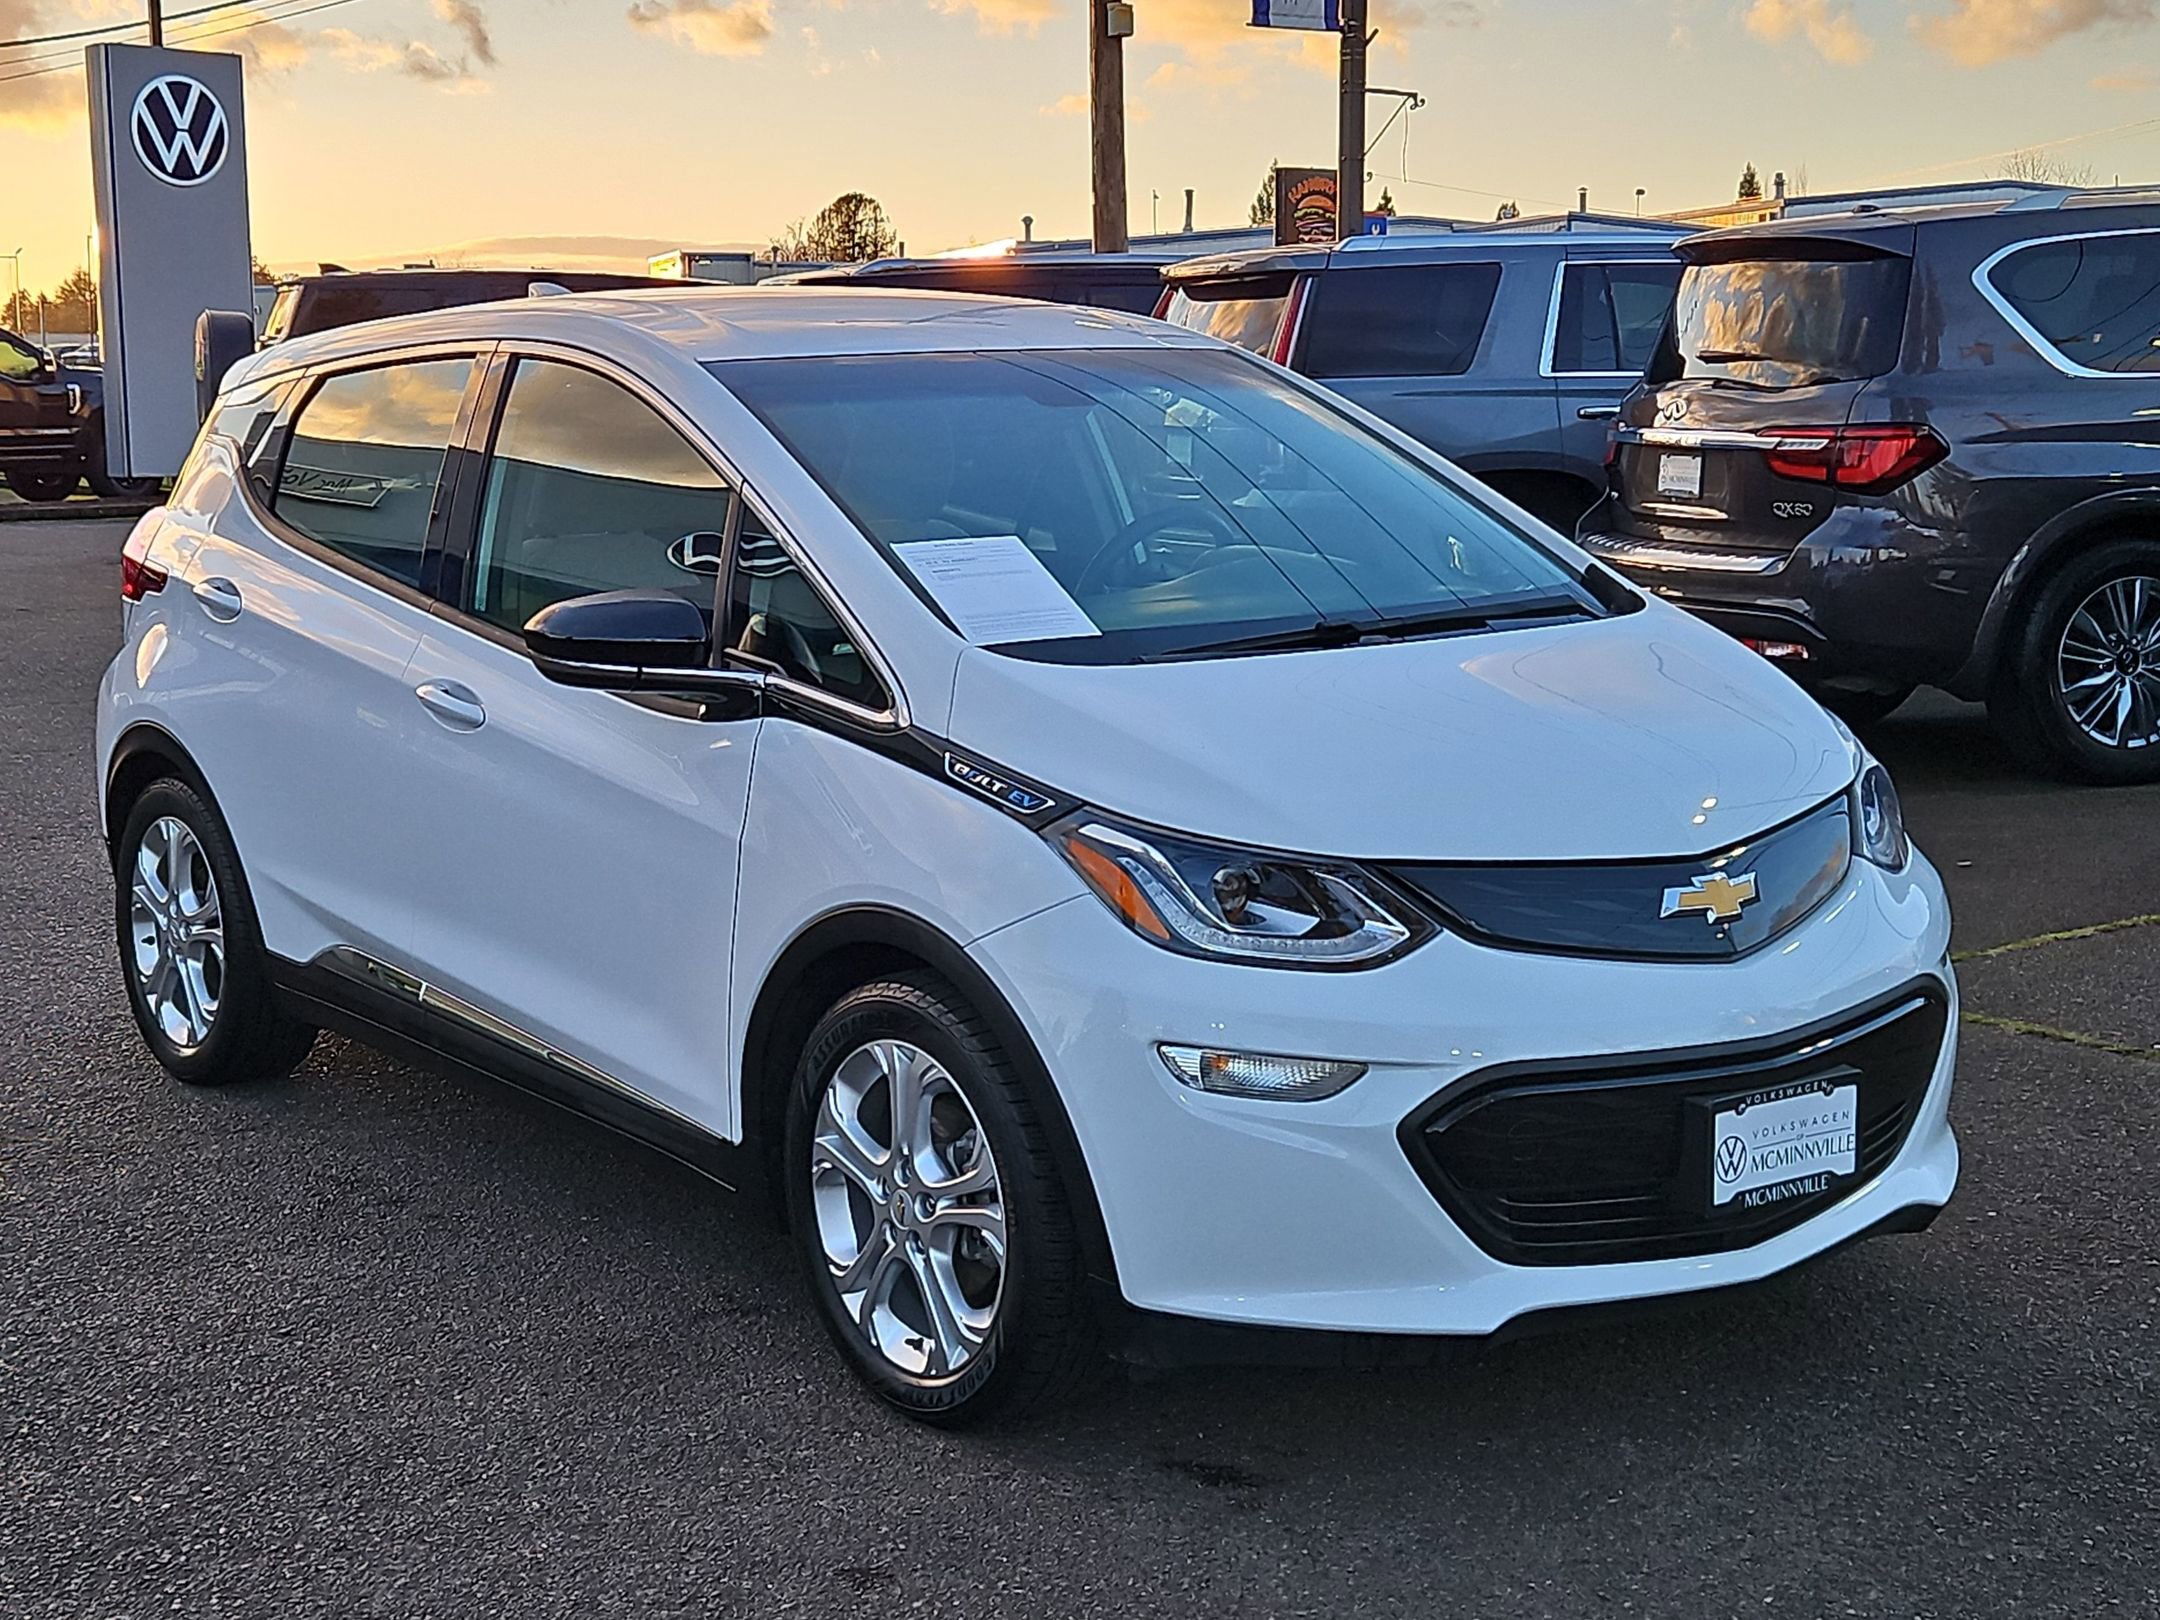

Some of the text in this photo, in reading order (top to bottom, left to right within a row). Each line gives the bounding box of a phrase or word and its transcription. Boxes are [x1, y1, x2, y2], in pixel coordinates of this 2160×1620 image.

[137, 79, 222, 175] VW
[953, 762, 1041, 807] BOLT EV
[1745, 1080, 1829, 1105] VOLKSWAGEN
[1752, 1110, 1850, 1139] VOLKSWAGEN
[1717, 1137, 1746, 1181] VW
[1751, 1133, 1856, 1173] MCMINNVILLE
[1744, 1174, 1830, 1208] MCMINNVILLE
